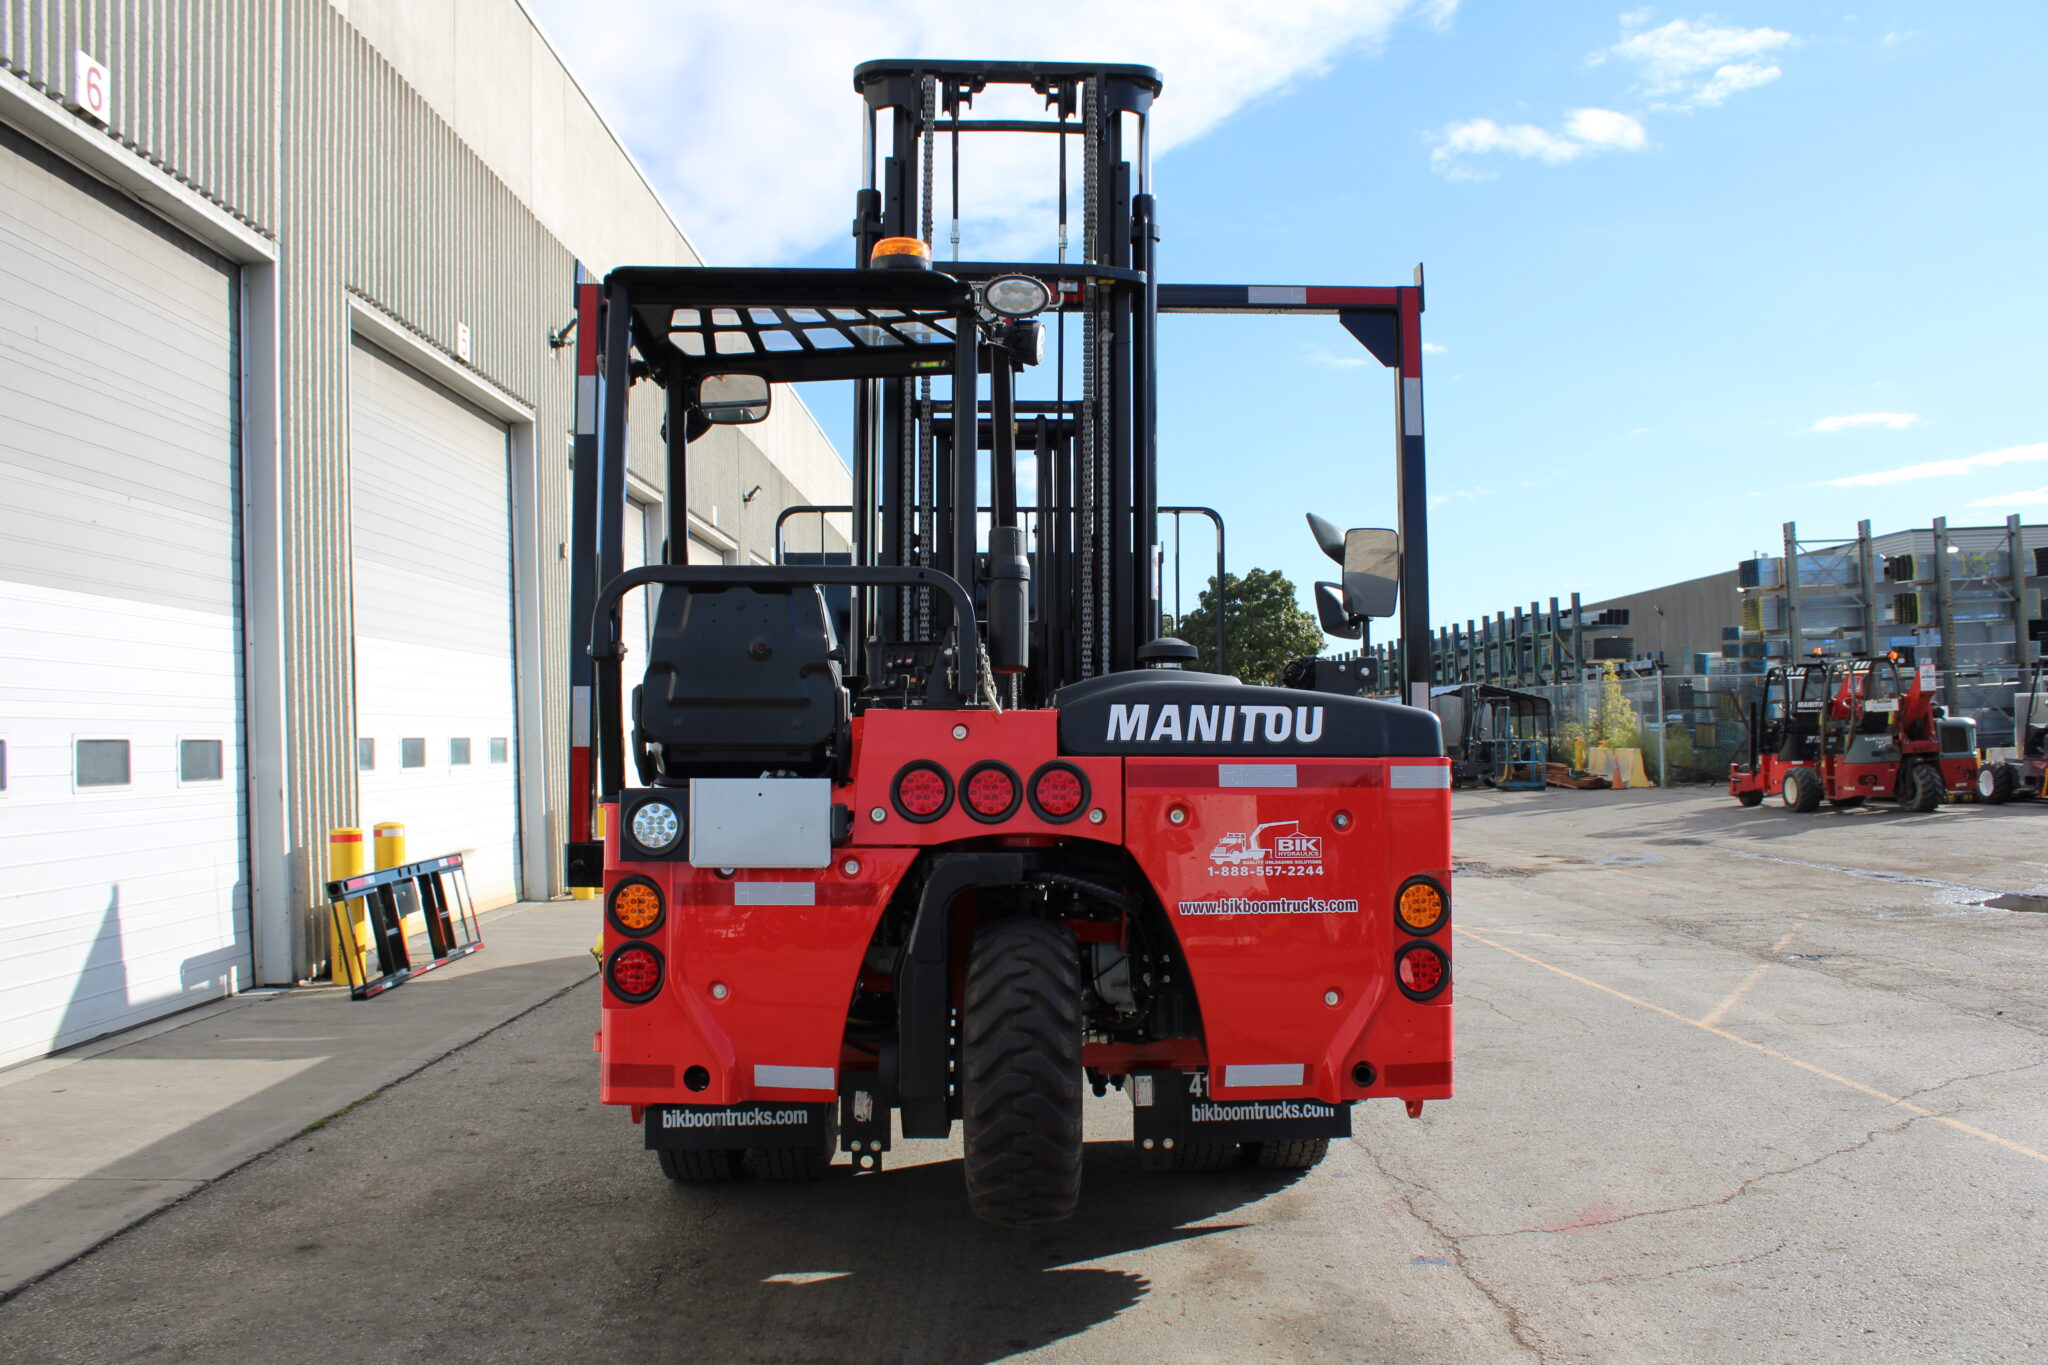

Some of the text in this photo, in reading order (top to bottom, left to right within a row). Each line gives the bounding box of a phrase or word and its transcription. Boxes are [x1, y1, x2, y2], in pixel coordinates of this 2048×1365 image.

[87, 66, 103, 112] 6
[1106, 703, 1325, 743] MANITOU
[1278, 839, 1319, 851] BIK
[1208, 865, 1324, 877] 1-888-557-2244
[1179, 897, 1358, 915] www.bikboomtrucks.com
[662, 1107, 808, 1129] bikboomtrucks.com
[1191, 1100, 1335, 1122] bikboomtrucks.com
